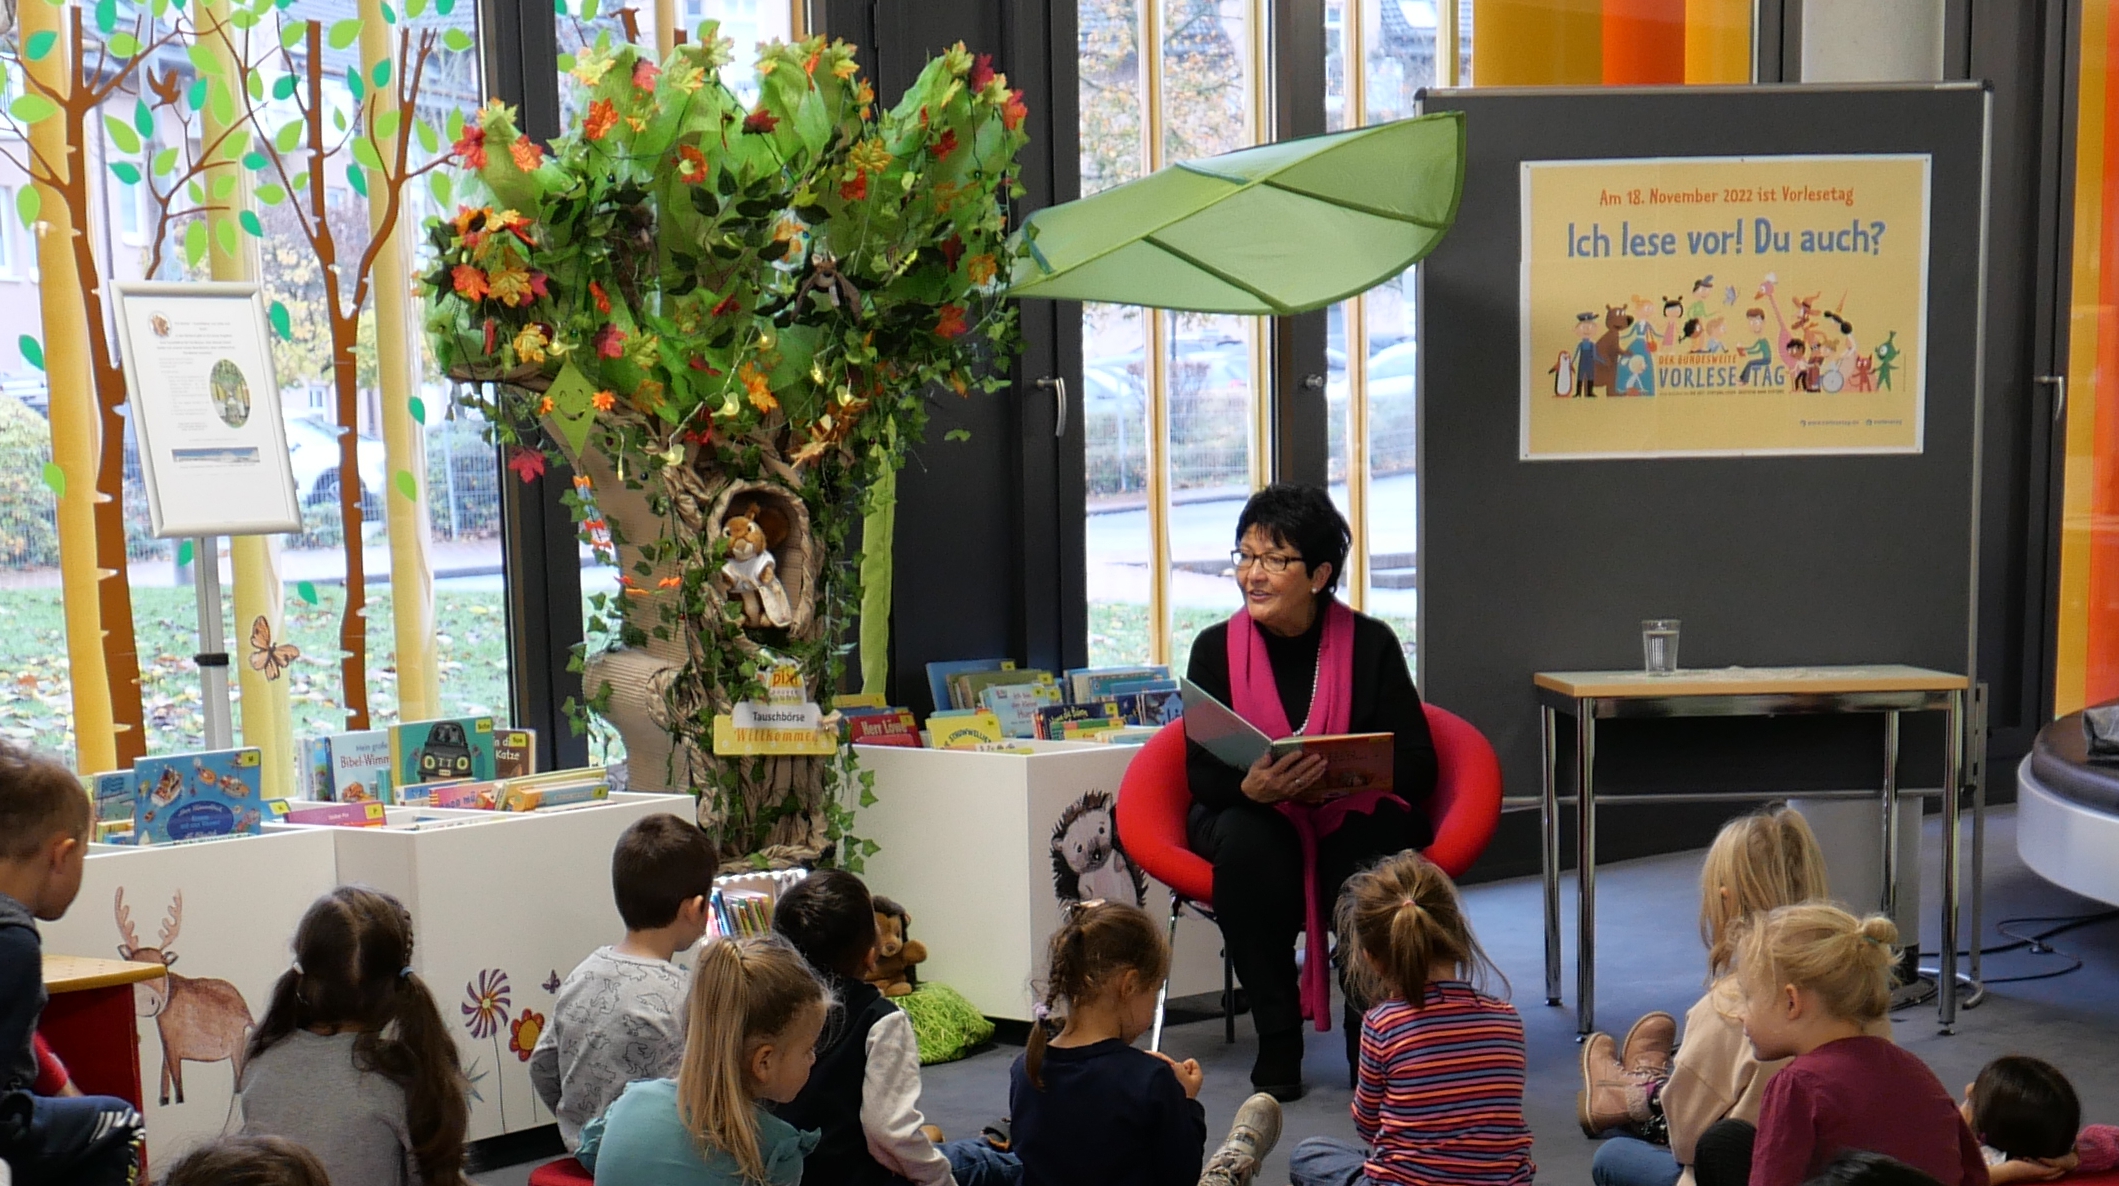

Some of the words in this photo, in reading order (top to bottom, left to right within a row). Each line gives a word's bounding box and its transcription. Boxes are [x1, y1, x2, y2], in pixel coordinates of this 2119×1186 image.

[1599, 188, 1622, 207] Am
[1627, 188, 1645, 206] 18.
[1649, 186, 1719, 205] November
[1723, 188, 1753, 203] 2022
[1757, 186, 1777, 203] ist
[1782, 185, 1854, 207] Vorlesetag
[1567, 222, 1611, 258] Ich
[1621, 220, 1677, 257] lese
[1687, 217, 1743, 256] vor!
[1754, 216, 1791, 254] Du
[1800, 217, 1887, 256] auch?
[1658, 354, 1674, 366] DER
[1677, 353, 1738, 365] BUNDESWEITE
[1659, 365, 1737, 388] VORLESE
[1751, 364, 1786, 387] TAG
[772, 670, 799, 688] pixi
[752, 711, 806, 722] Tauschbörse
[860, 721, 883, 736] Herr
[495, 749, 520, 761] Katze
